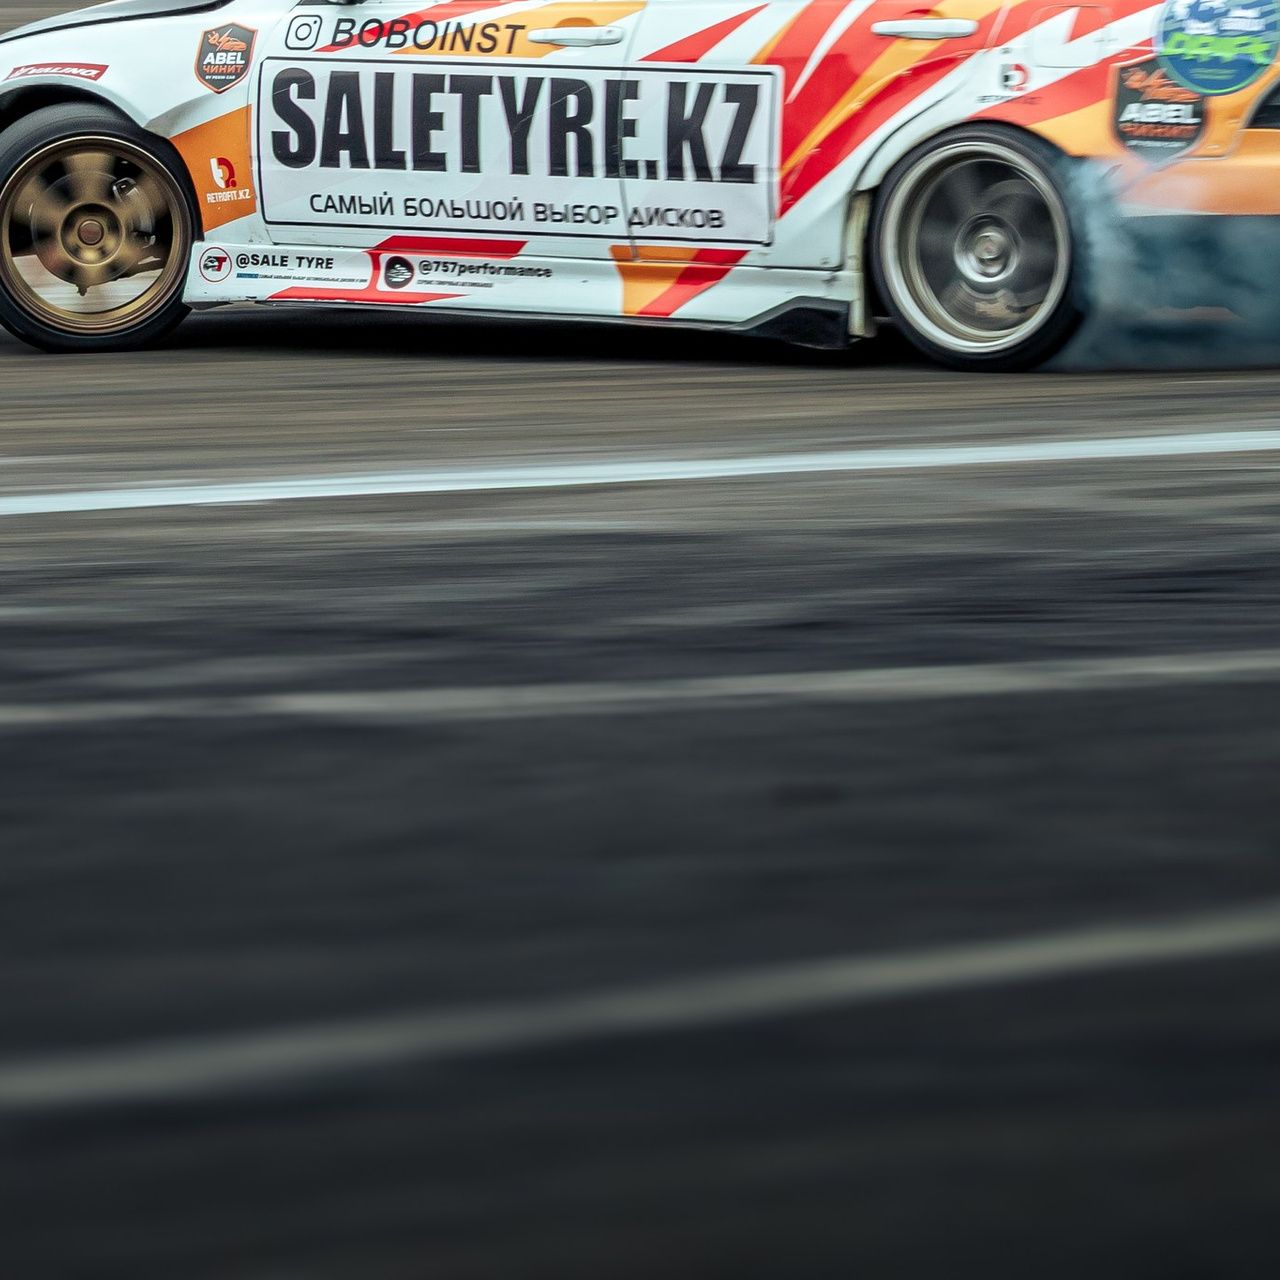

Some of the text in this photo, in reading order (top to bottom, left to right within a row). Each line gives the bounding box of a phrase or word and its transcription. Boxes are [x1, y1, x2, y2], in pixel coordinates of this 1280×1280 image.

[331, 18, 526, 54] BOBOINST
[203, 52, 245, 65] ABEL
[203, 65, 243, 74] ЧИНИТ
[271, 67, 760, 184] SALETYRE.KZ
[206, 189, 251, 203] RETROFIT.KZ
[309, 191, 726, 228] САМЫЙ БОЛЬШОЙ ВЫБОР ДИСКОВ
[235, 254, 334, 270] @SALE_TYRE
[419, 260, 553, 277] @757performance
